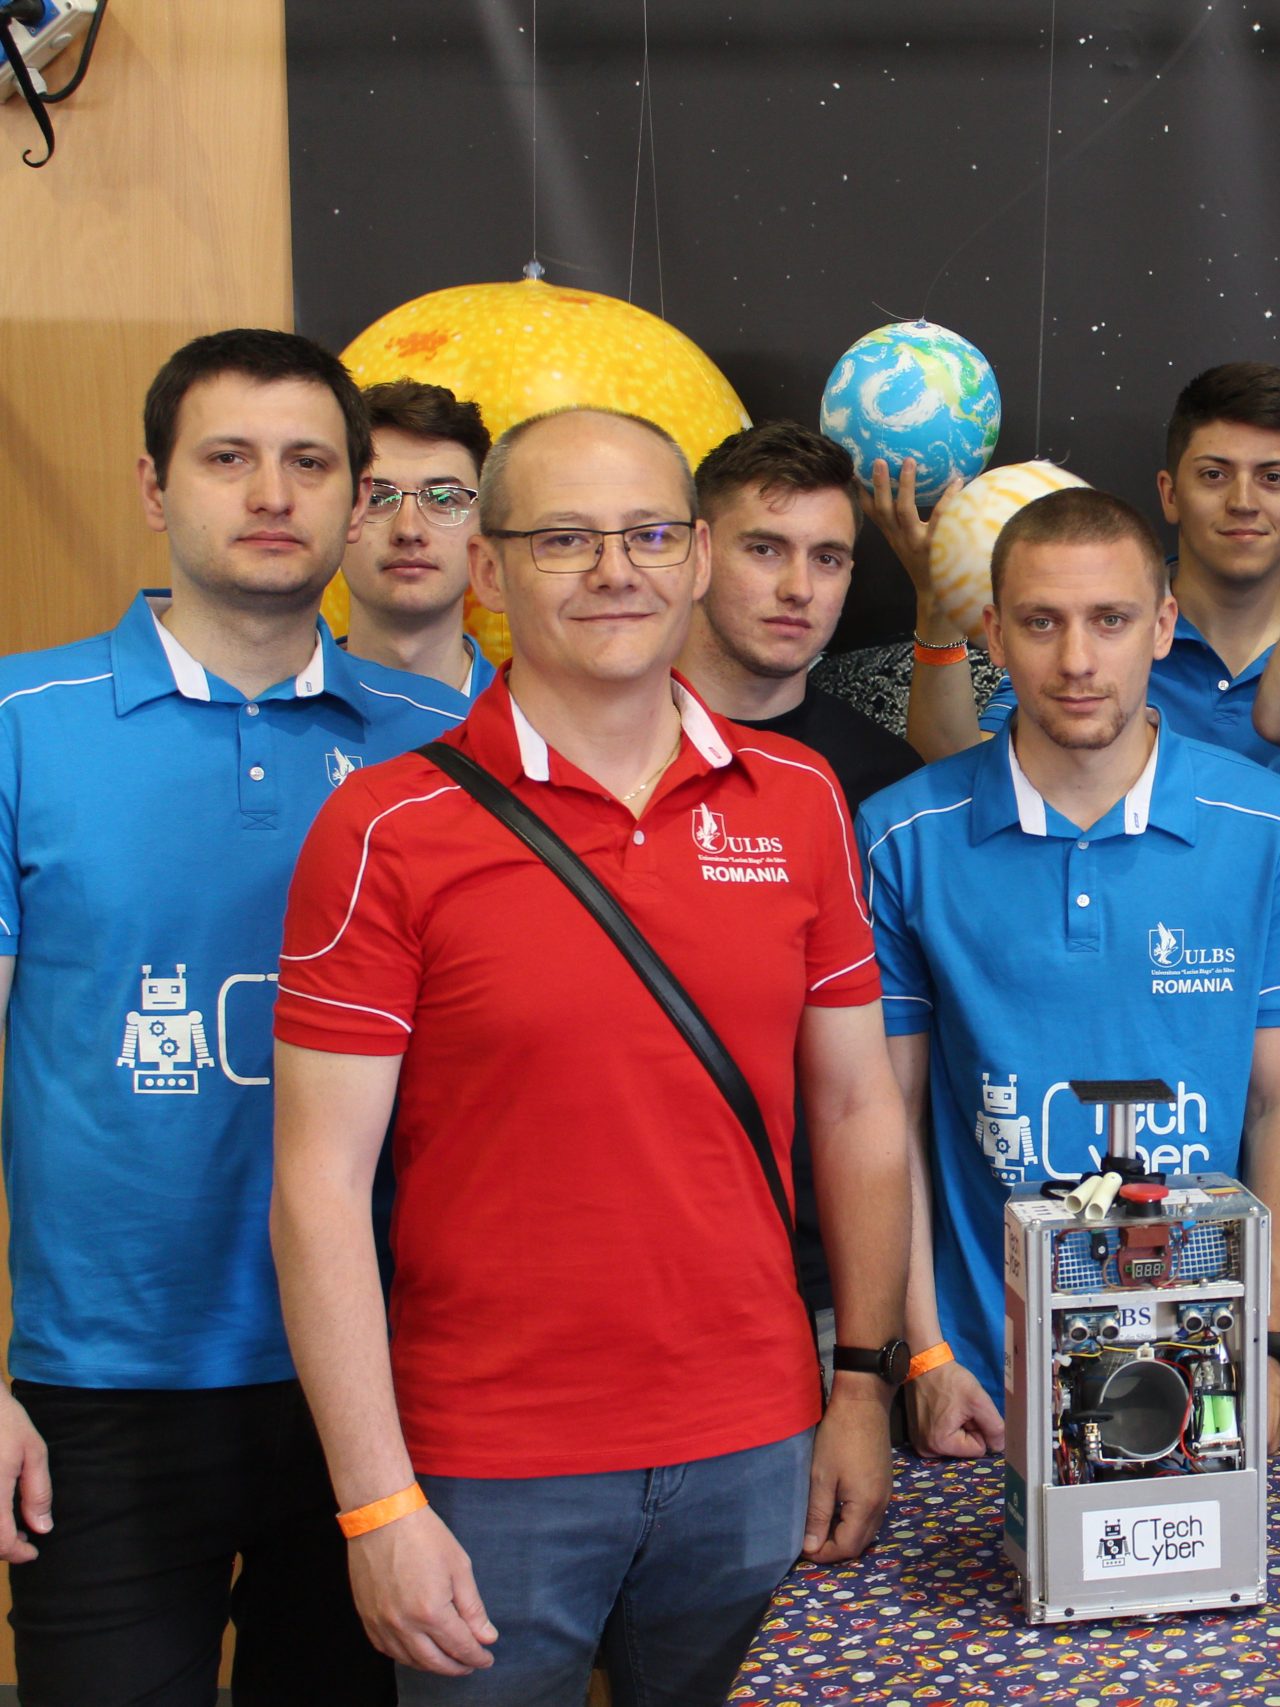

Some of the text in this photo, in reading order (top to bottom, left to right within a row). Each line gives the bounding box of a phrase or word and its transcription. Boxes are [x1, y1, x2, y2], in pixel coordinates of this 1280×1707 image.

[727, 837, 783, 853] ULBS
[701, 865, 789, 883] ROMANIA
[1184, 948, 1235, 965] ULBS
[1152, 977, 1233, 994] ROMANIA
